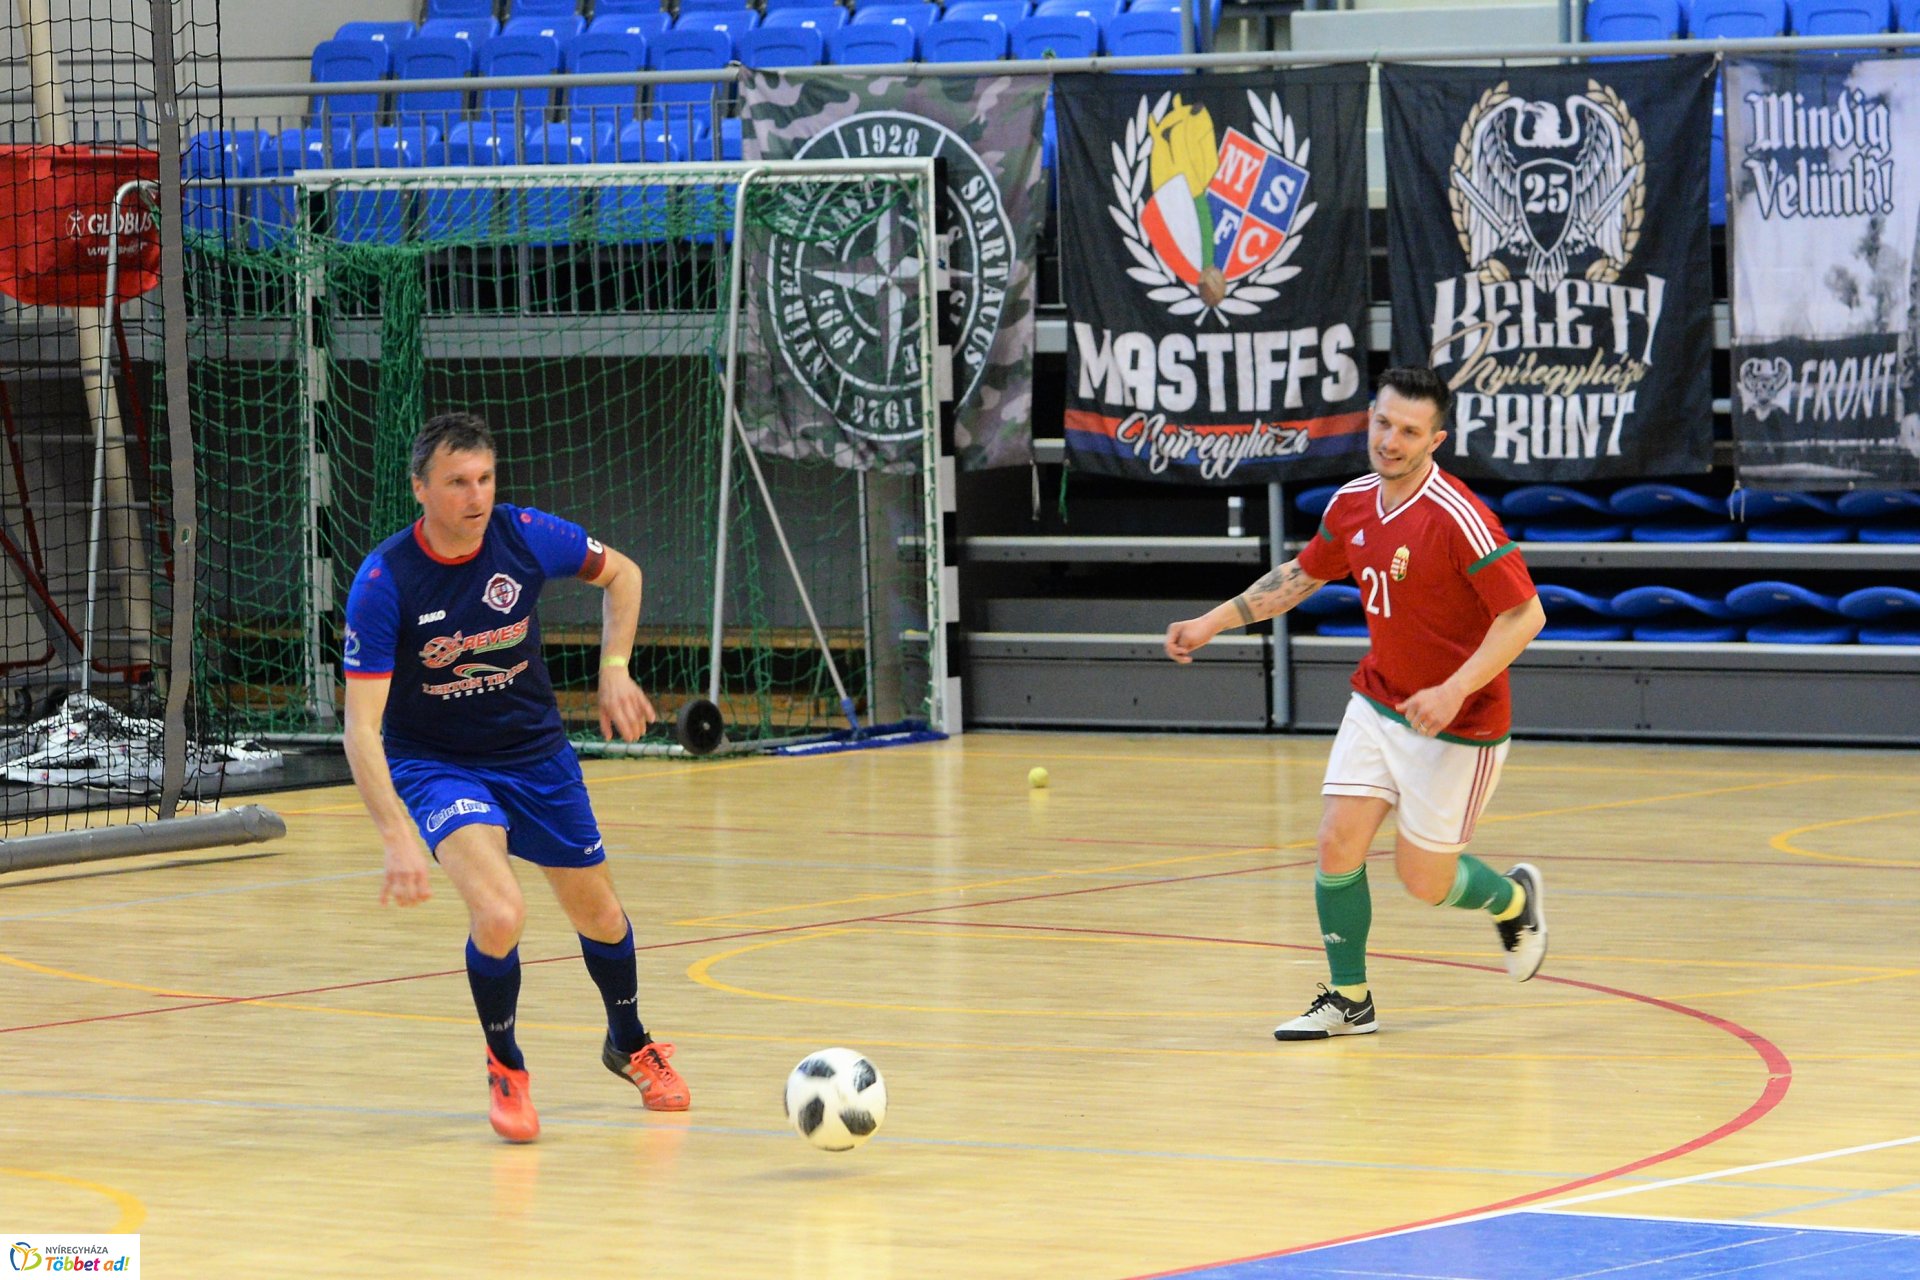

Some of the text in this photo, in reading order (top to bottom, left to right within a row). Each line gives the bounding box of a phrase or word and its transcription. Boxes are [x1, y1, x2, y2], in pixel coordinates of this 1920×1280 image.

[855, 123, 920, 157] 1928
[1745, 88, 1892, 162] Mindig
[1215, 142, 1259, 193] NY
[1524, 172, 1568, 214] 25
[1744, 150, 1894, 220] Velünk!
[960, 174, 1009, 370] SPARTACUS
[1073, 321, 1359, 413] MASTIFFS
[1796, 351, 1897, 424] FRONT
[1454, 390, 1637, 465] FRONT
[417, 609, 447, 626] JAKO
[1361, 566, 1392, 619] 21
